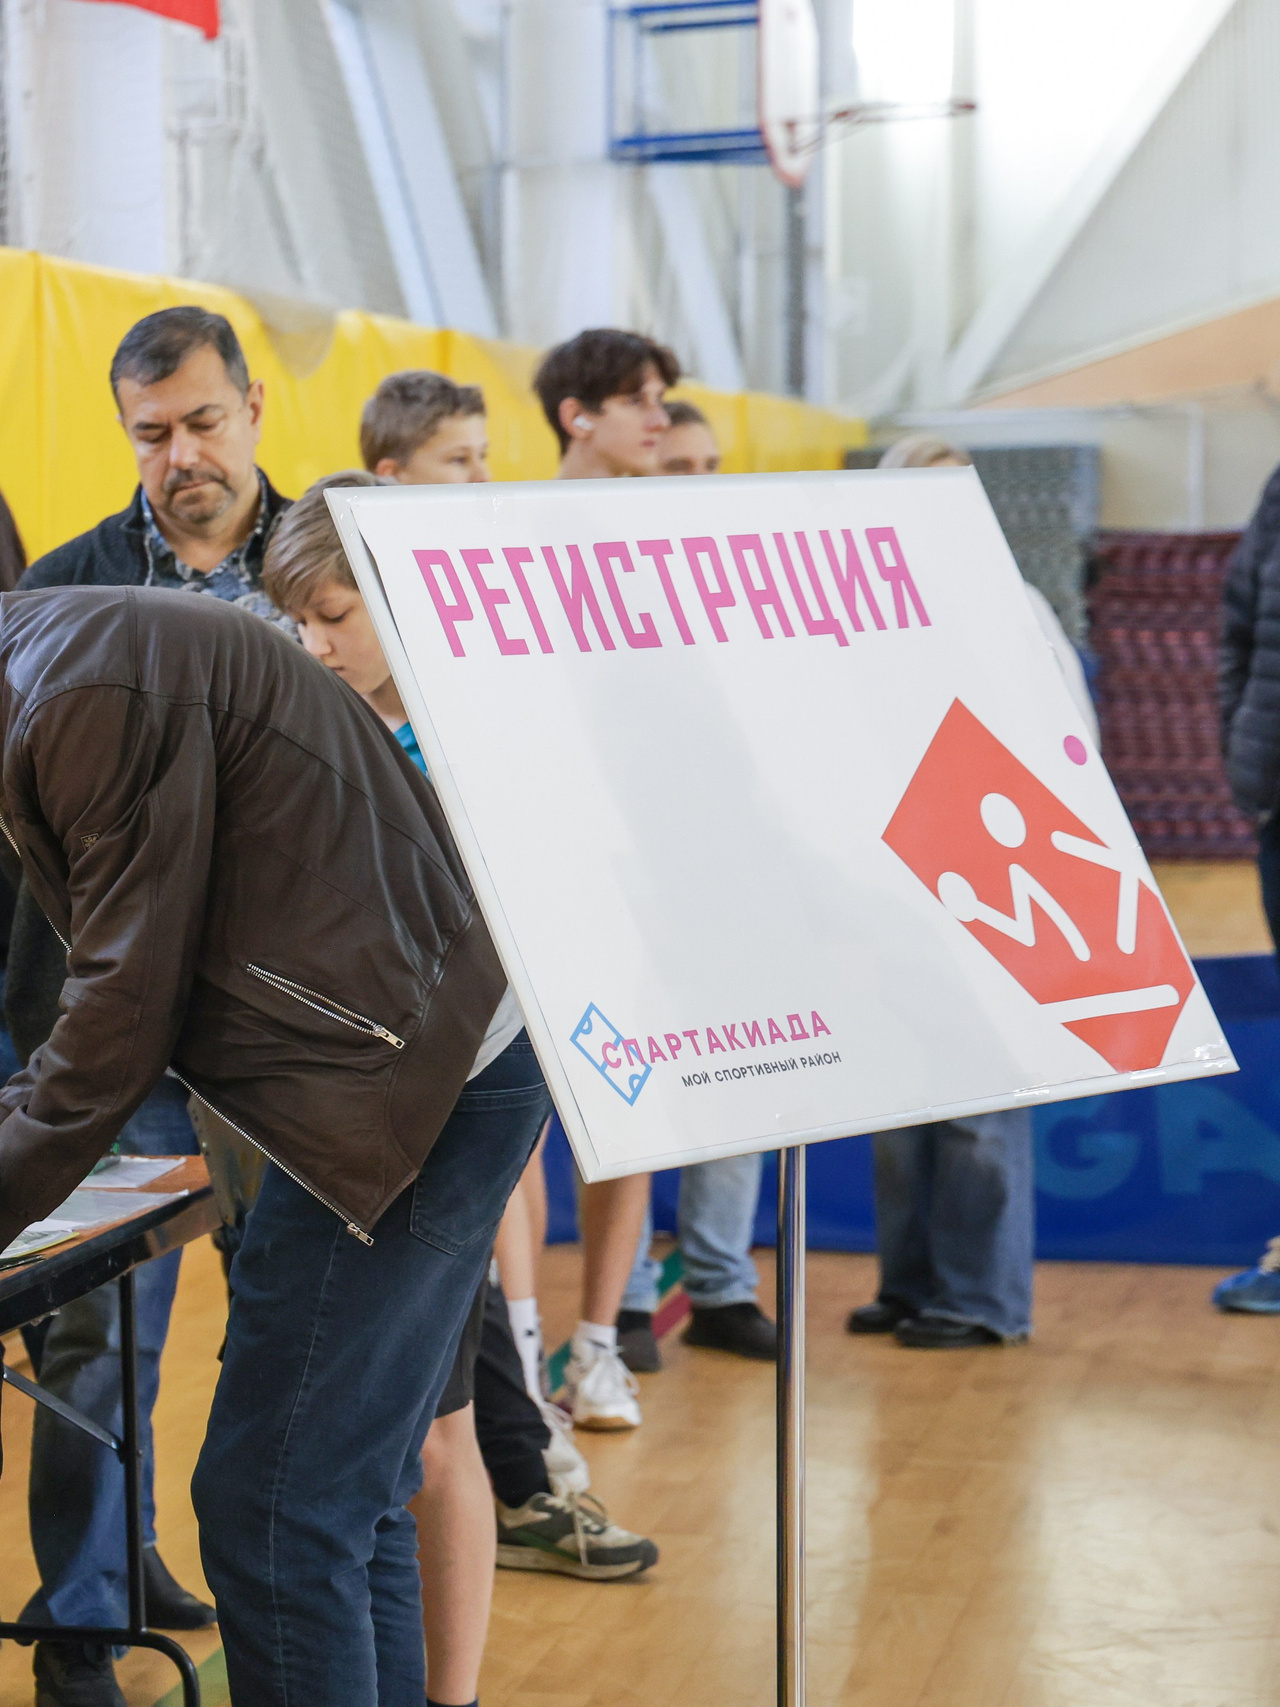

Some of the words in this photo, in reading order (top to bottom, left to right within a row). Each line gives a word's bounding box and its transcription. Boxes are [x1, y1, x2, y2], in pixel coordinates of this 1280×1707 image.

[412, 527, 932, 657] РЕГИСТРАЦИЯ
[601, 1010, 832, 1069] СПАРТАКИАДА
[681, 1070, 711, 1087] МОЙ
[714, 1057, 799, 1082] СПОРТИВНЫЙ
[801, 1051, 842, 1069] РАЙОН
